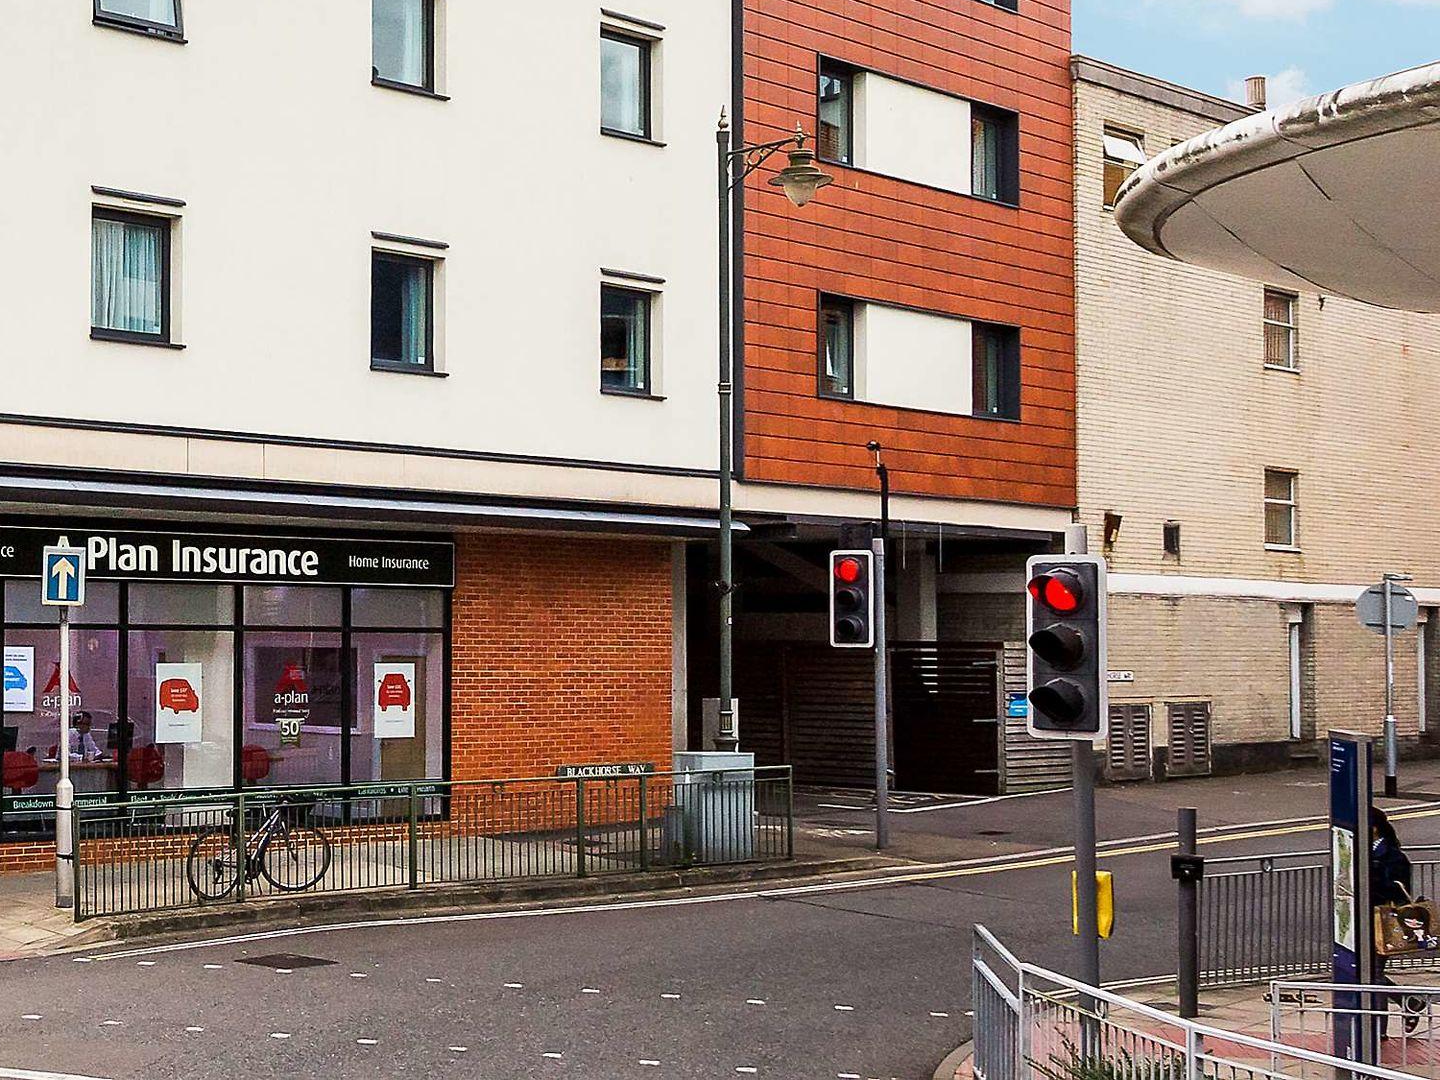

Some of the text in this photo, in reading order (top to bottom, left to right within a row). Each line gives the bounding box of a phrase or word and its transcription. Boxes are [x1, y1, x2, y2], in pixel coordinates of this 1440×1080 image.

[57, 535, 319, 576] Plan Insurance
[348, 555, 430, 570] Home Insurance
[42, 694, 82, 709] a-pan
[273, 690, 309, 706] a-plan
[281, 720, 300, 736] 50
[566, 764, 647, 778] BLACKHORSE WAY
[13, 796, 108, 809] Breakdown mmercial
